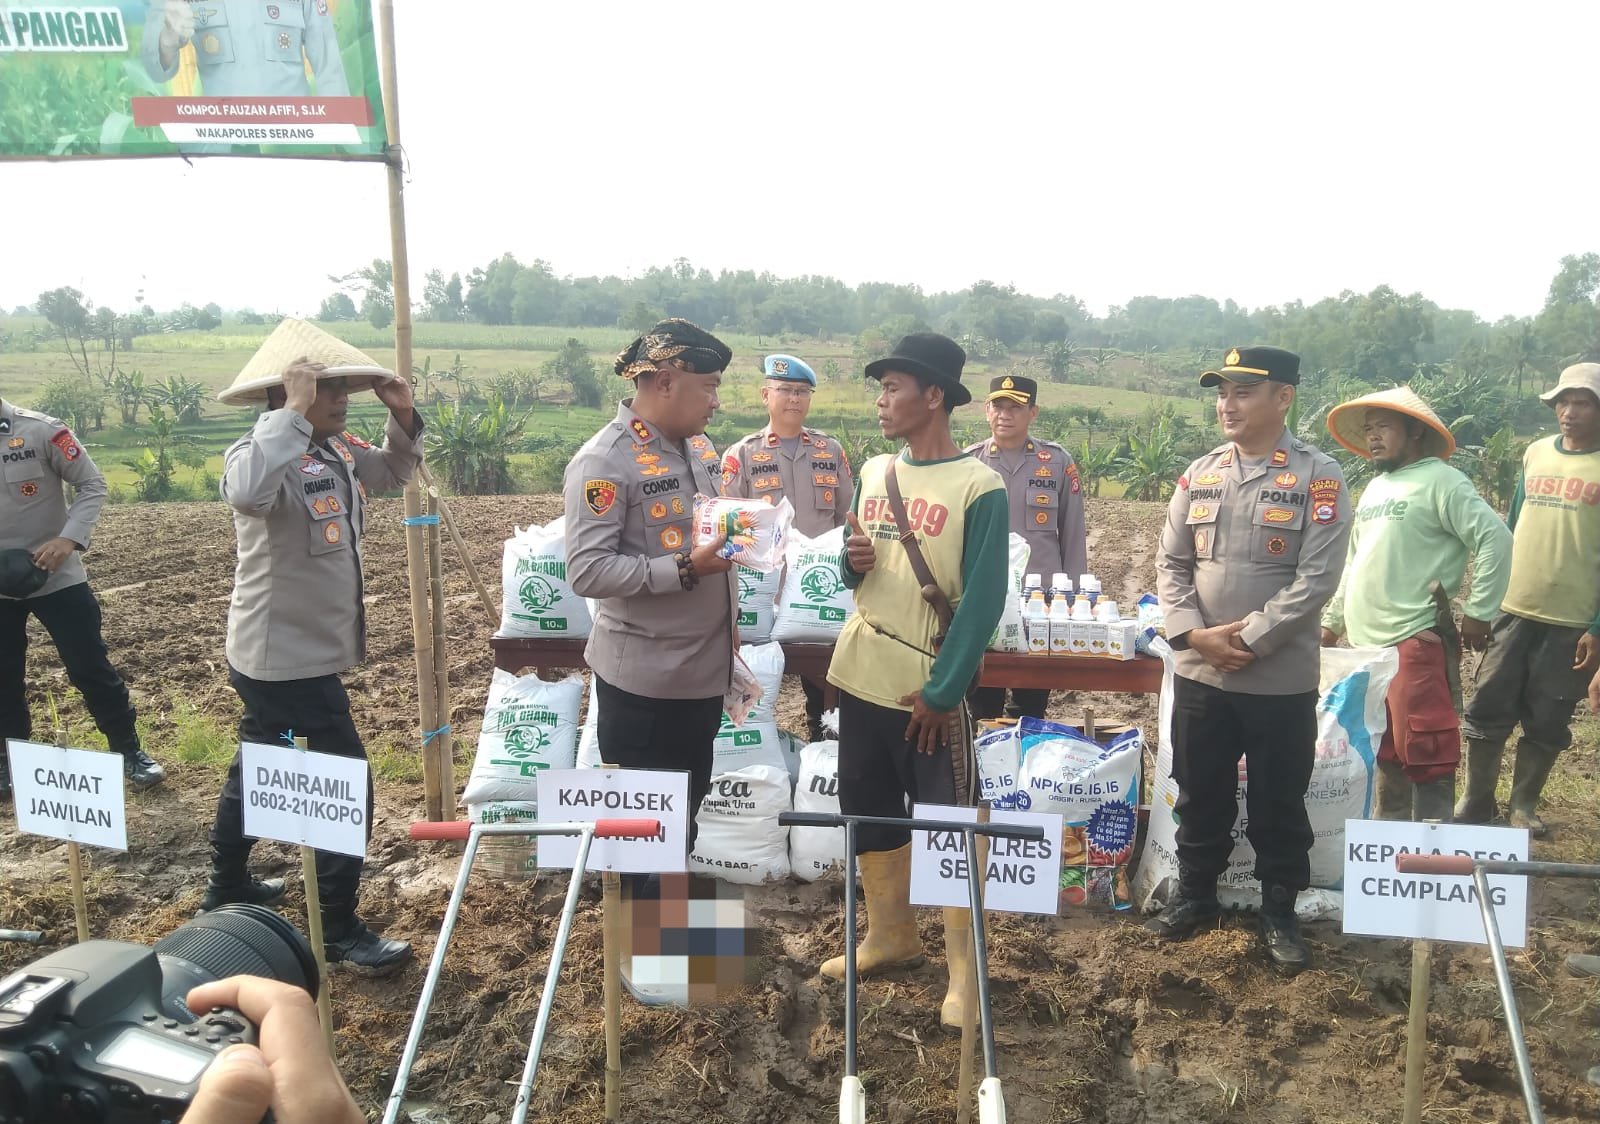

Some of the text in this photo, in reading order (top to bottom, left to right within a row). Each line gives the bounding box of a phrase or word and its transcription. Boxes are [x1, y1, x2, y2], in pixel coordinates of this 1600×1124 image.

[10, 11, 124, 47] PANGAN
[176, 104, 326, 117] KOMPOL FAUZAN AFIFI, S.I.K
[195, 127, 314, 139] WAKAPOLRES SERANG
[2, 449, 36, 463] POLRI
[750, 463, 778, 475] JHONI
[812, 461, 836, 471] POLRI
[642, 478, 679, 495] CONDRO
[1028, 479, 1057, 489] POLRI
[1260, 490, 1305, 506] POLRI
[824, 609, 835, 618] 10
[545, 620, 556, 628] 10
[739, 733, 751, 743] 10
[986, 734, 1006, 744] PUPUK
[34, 767, 103, 795] CAMAT
[256, 766, 356, 802] DANRAMIL
[1030, 777, 1119, 795] NPK 16.16.16
[558, 788, 674, 812] KAPOLSEK
[1048, 794, 1074, 803] ORIGIN
[1303, 788, 1350, 799] ONESIA
[703, 798, 755, 809] Pupuk Urea
[1019, 796, 1028, 805] 20
[30, 798, 112, 828] JAWILAN
[250, 790, 363, 826] 0602-21/KOPO
[926, 829, 1052, 859] KALRES
[1113, 837, 1126, 845] ppm
[724, 861, 749, 869] BAG
[939, 858, 1036, 885] SEANG
[1229, 870, 1255, 885] (PERS
[1361, 877, 1506, 906] CEMPLANG
